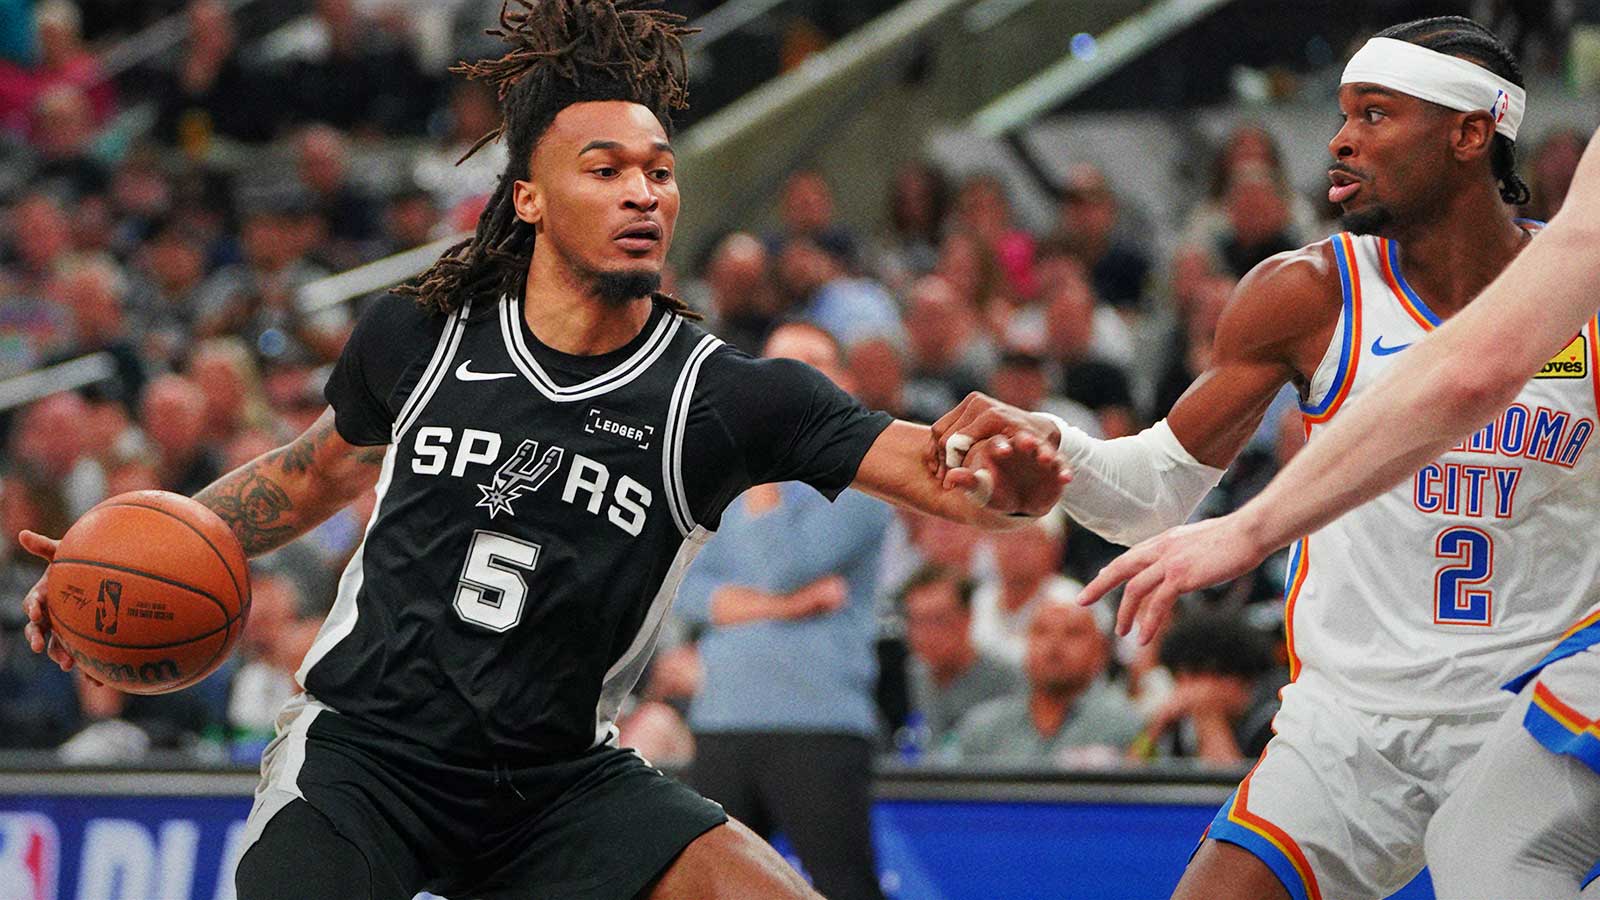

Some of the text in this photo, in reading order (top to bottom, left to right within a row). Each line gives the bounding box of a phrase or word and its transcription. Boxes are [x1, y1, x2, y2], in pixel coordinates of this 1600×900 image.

[595, 417, 645, 441] LEDGER
[413, 427, 653, 536] SPURS
[1415, 464, 1521, 517] CITY
[454, 530, 542, 632] 5
[1435, 526, 1493, 626] 2
